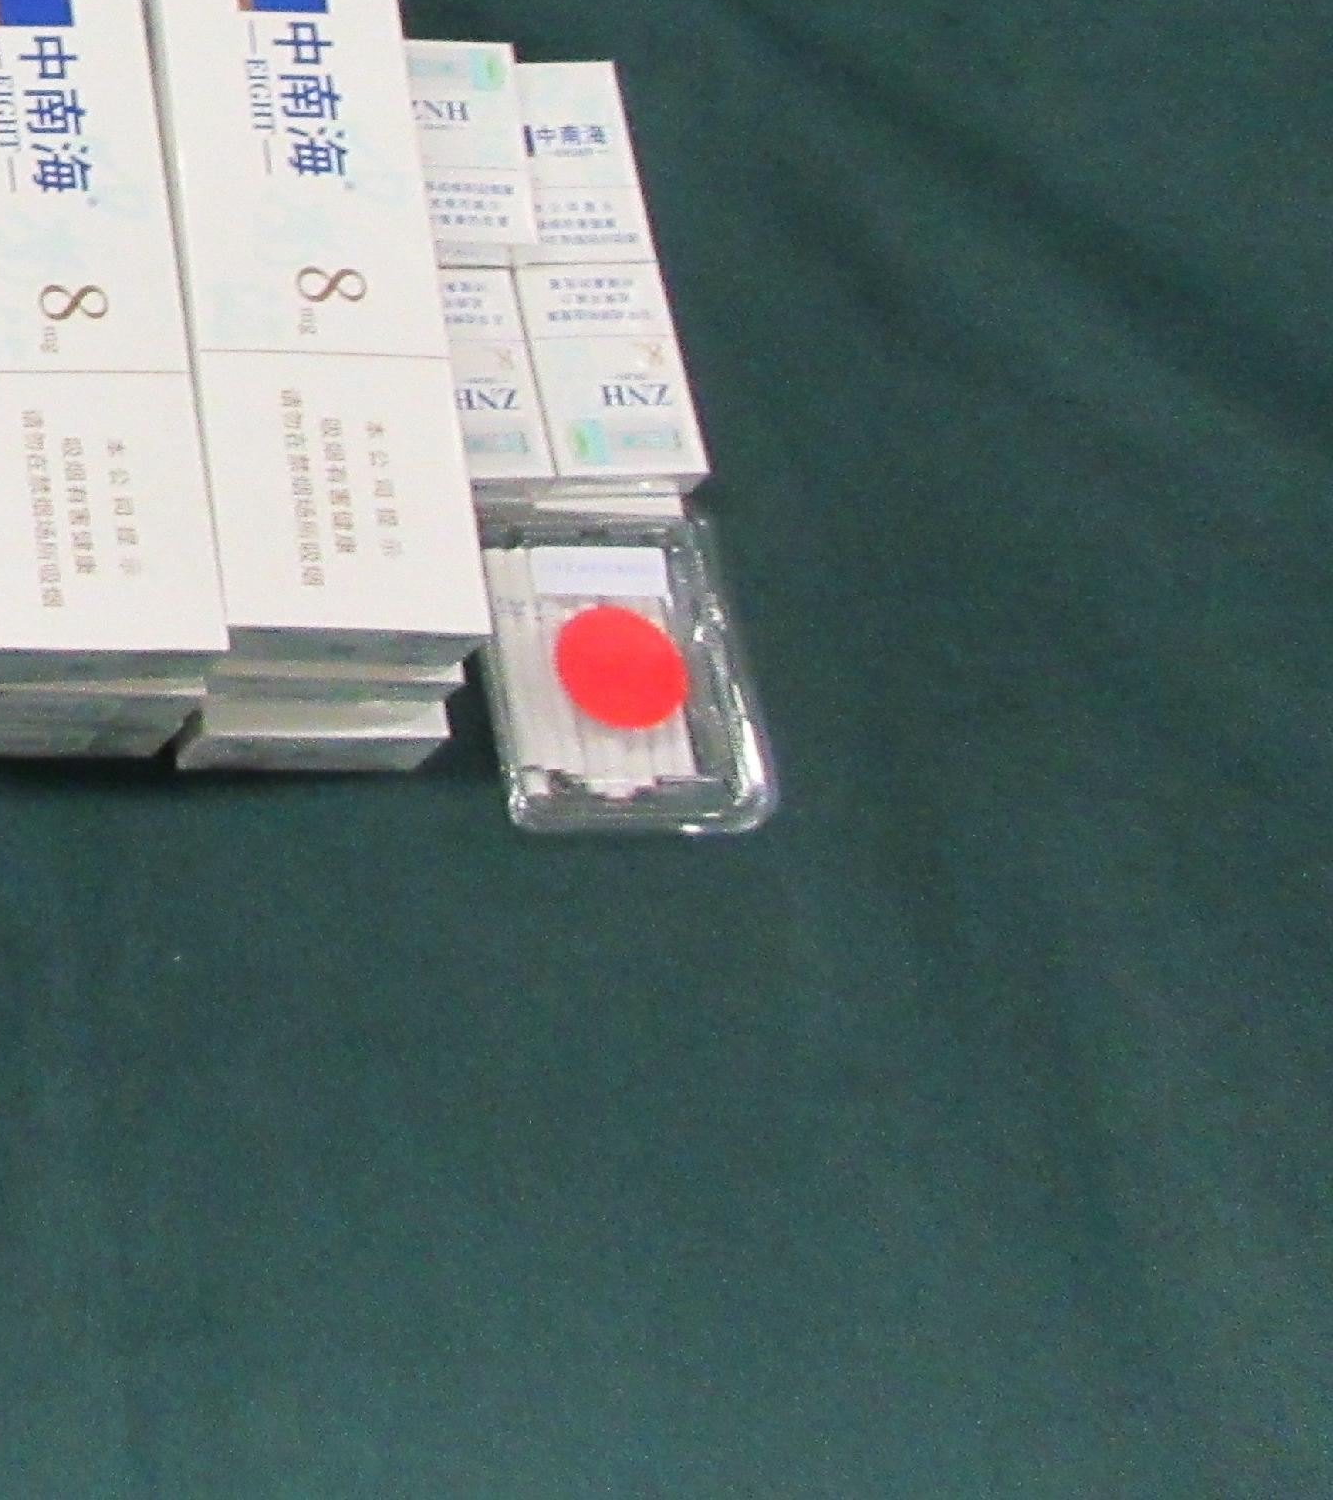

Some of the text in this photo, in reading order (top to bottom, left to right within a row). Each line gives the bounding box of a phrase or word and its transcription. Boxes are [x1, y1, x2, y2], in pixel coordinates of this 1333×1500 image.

[18, 34, 93, 193] 中南海
[245, 58, 276, 133] EIGHT
[271, 21, 348, 177] 中南海
[37, 283, 109, 321] 8
[295, 266, 367, 303] 8
[599, 383, 674, 406] ZNH
